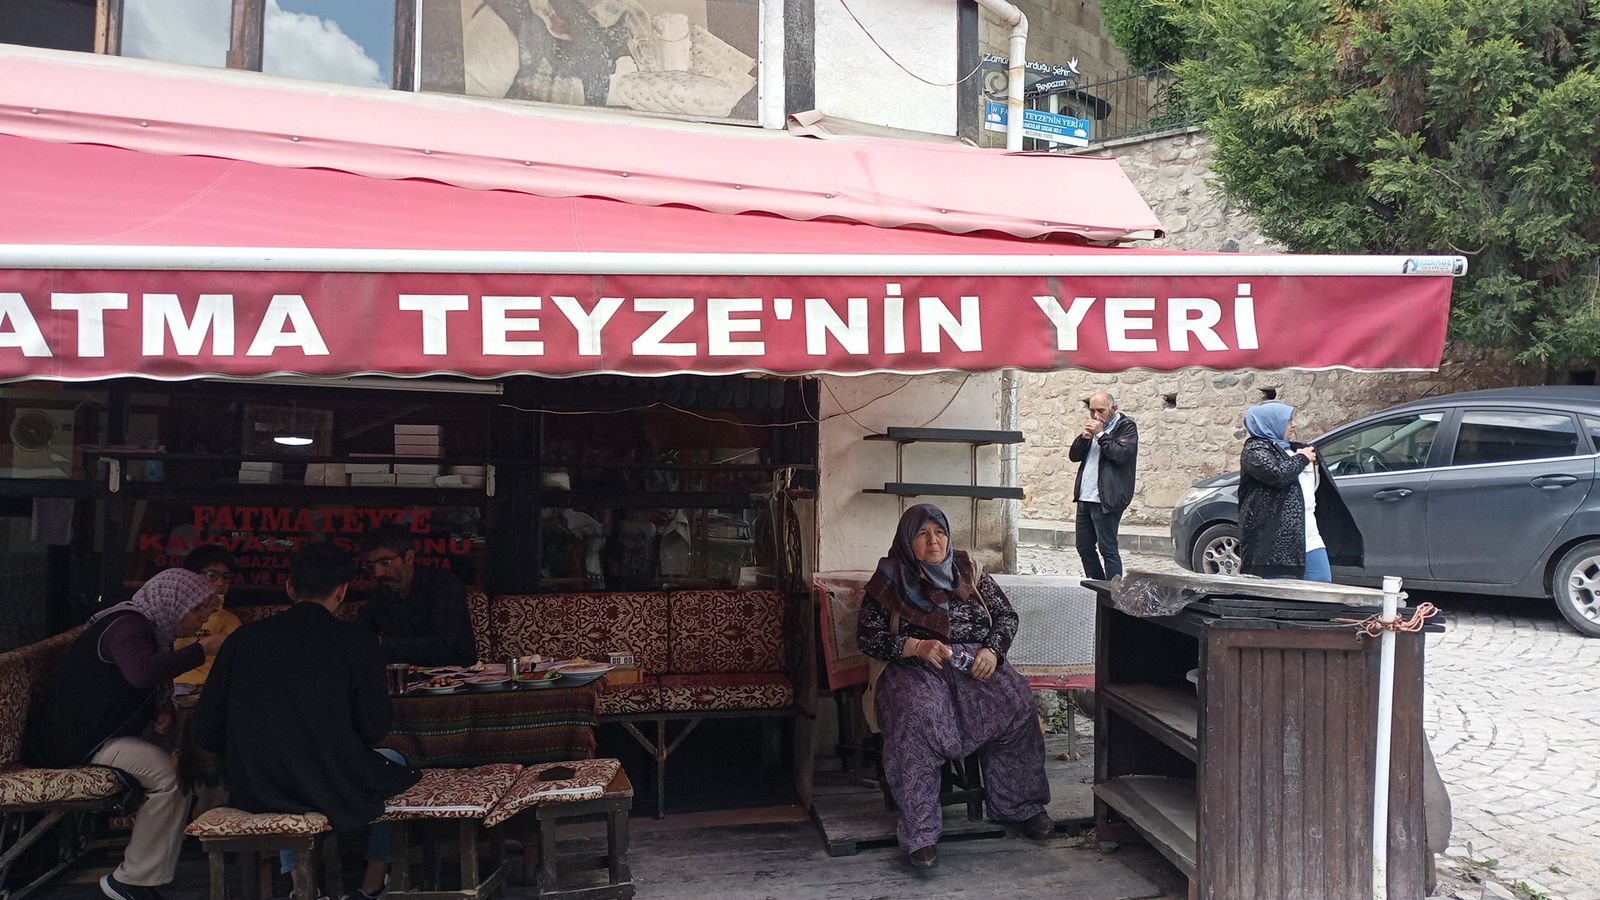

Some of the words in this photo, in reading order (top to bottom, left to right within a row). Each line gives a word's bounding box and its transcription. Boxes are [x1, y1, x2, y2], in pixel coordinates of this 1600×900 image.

[984, 53, 1008, 64] Zama
[1024, 61, 1050, 73] urduğu
[1052, 65, 1070, 76] Şehir
[1025, 112, 1061, 125] TEYZE'NİN
[1062, 118, 1078, 128] YERİ
[399, 283, 982, 356] TEYZE'NİN
[1032, 283, 1260, 352] YERİ
